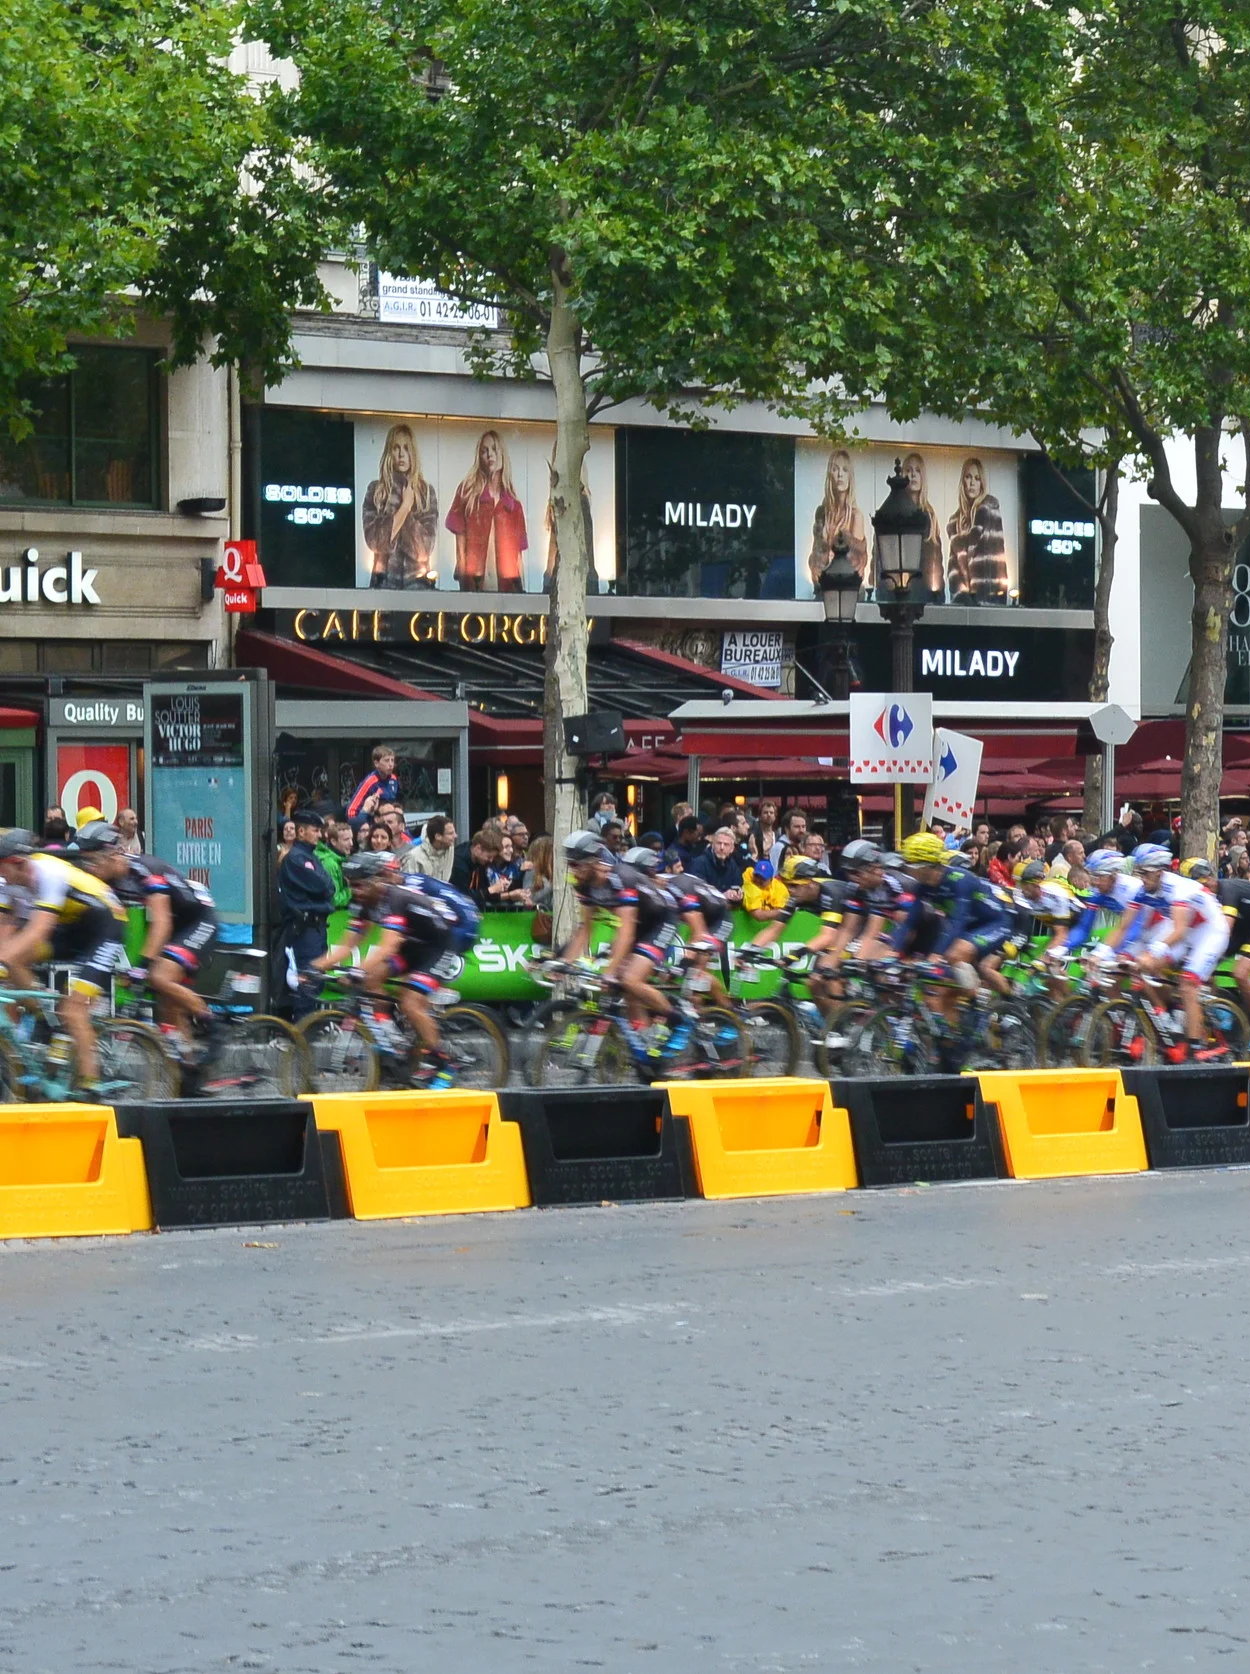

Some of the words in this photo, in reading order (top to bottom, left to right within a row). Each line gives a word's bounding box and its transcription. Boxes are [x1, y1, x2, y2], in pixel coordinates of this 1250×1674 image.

[382, 284, 408, 295] grand
[264, 484, 352, 504] SOLDES
[664, 501, 757, 528] MILADY
[222, 547, 243, 582] Q
[225, 592, 248, 605] Quick
[728, 633, 738, 647] A
[743, 634, 781, 648] LOUER
[724, 648, 782, 662] BUREAUX
[922, 649, 1020, 677] MILADY
[170, 695, 200, 711] LOUIS
[64, 702, 119, 725] Quality
[158, 724, 200, 739] VICTOR
[168, 738, 200, 752] HUGO
[184, 817, 214, 838] PARIS
[176, 841, 206, 865] ENTRE
[208, 841, 221, 865] EN
